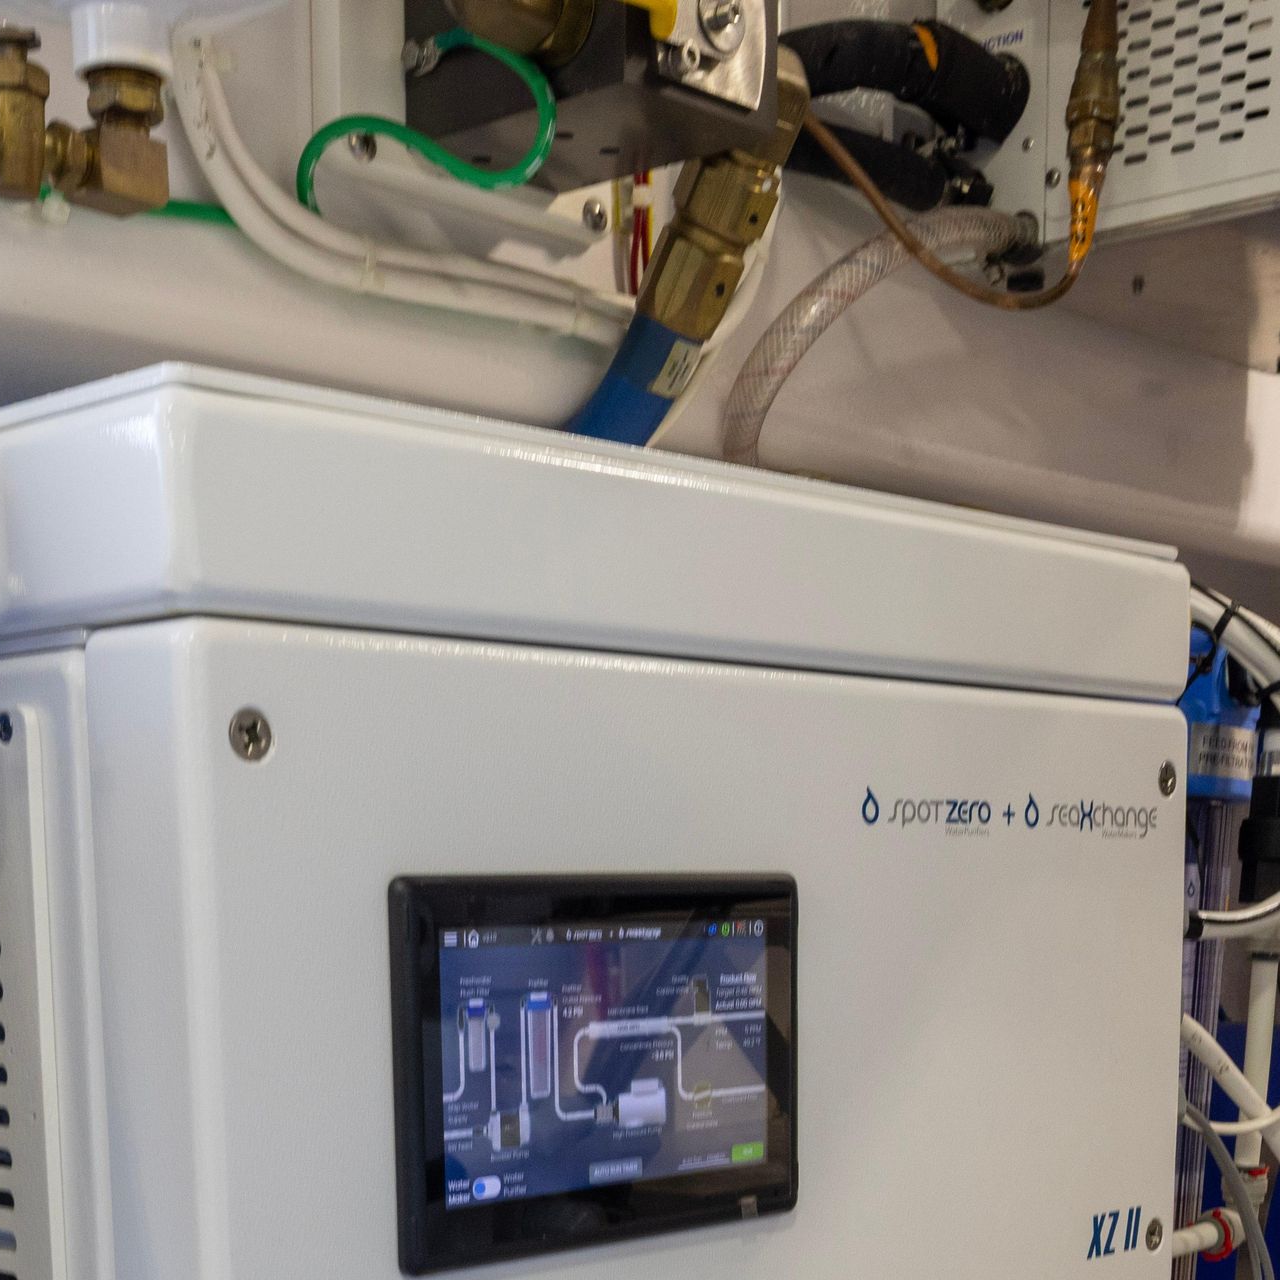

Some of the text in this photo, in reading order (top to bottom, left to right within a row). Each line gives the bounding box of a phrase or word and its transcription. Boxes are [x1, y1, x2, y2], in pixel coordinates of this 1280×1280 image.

[447, 1177, 470, 1192] Water
[448, 1191, 470, 1206] Maker
[1087, 1211, 1120, 1261] XZ
